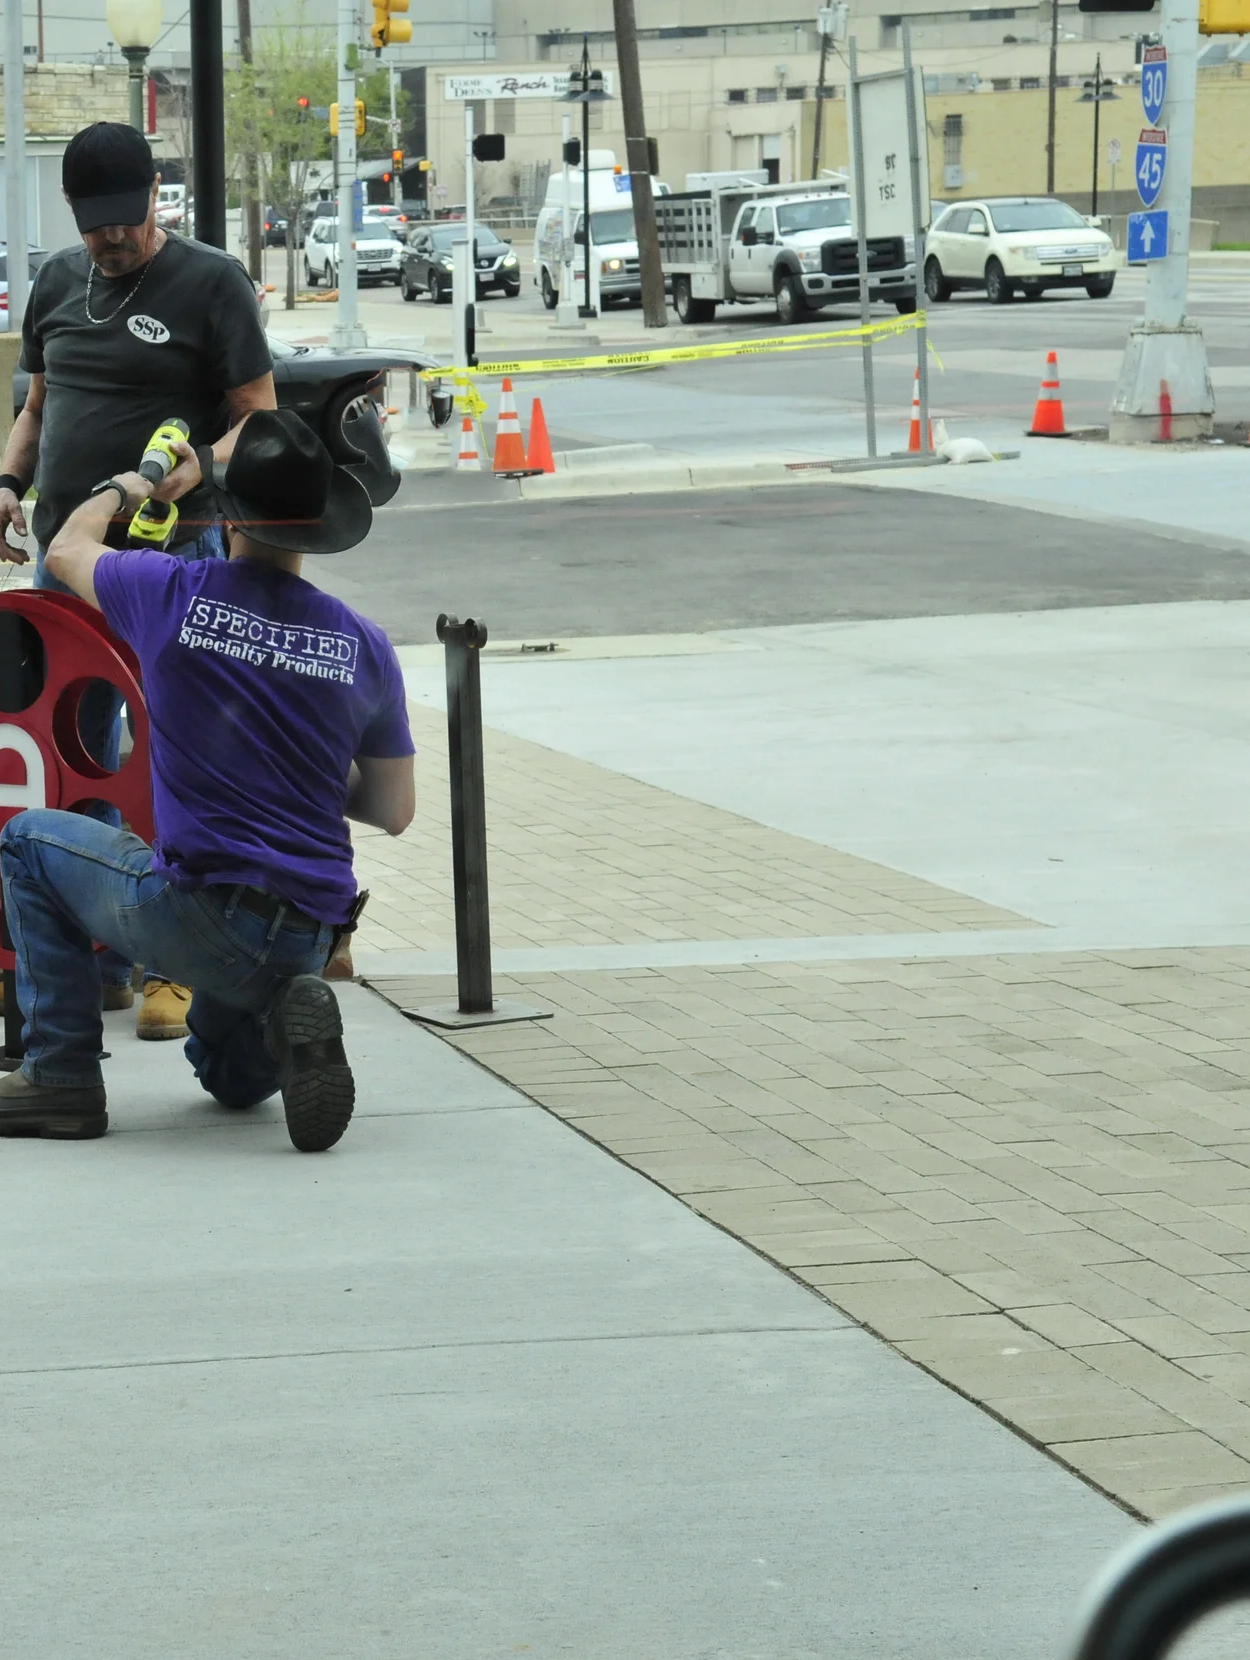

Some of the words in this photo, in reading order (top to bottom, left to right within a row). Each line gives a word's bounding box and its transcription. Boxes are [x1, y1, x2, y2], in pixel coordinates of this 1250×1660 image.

[496, 76, 550, 95] Ranch
[1144, 69, 1163, 107] 30
[1138, 152, 1162, 189] 45
[879, 183, 896, 201] TSC
[133, 316, 166, 341] SSP
[192, 603, 352, 662] SPECIFIED
[178, 627, 268, 667] Specialty
[271, 651, 355, 686] Products
